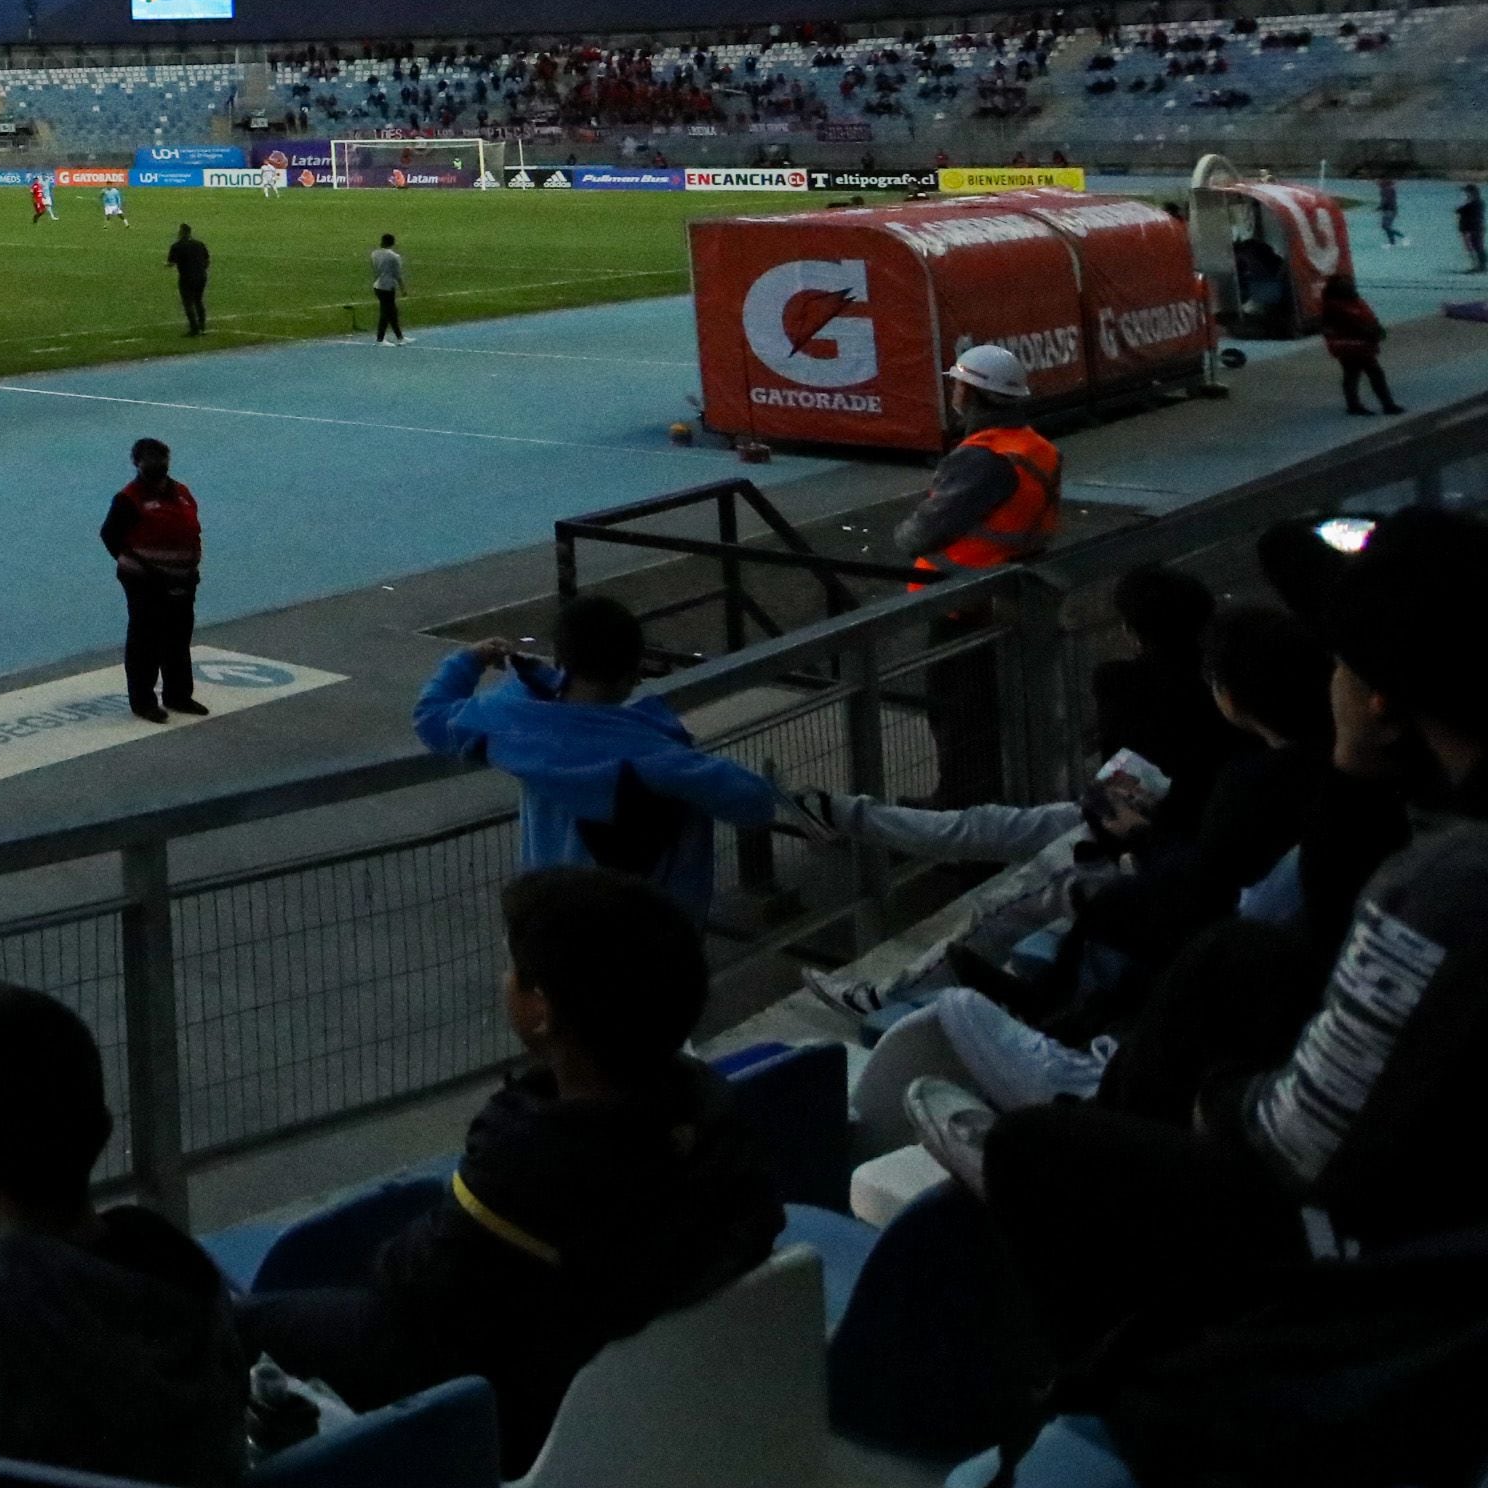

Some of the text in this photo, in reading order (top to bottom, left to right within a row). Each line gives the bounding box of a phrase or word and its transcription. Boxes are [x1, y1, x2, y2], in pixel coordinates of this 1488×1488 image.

[73, 171, 125, 182] GATORADE
[582, 174, 670, 183] Pullman Bus
[687, 173, 783, 186] ENCANCHA
[967, 174, 1054, 186] BIENVENIDA FM
[750, 387, 882, 413] GATORADE
